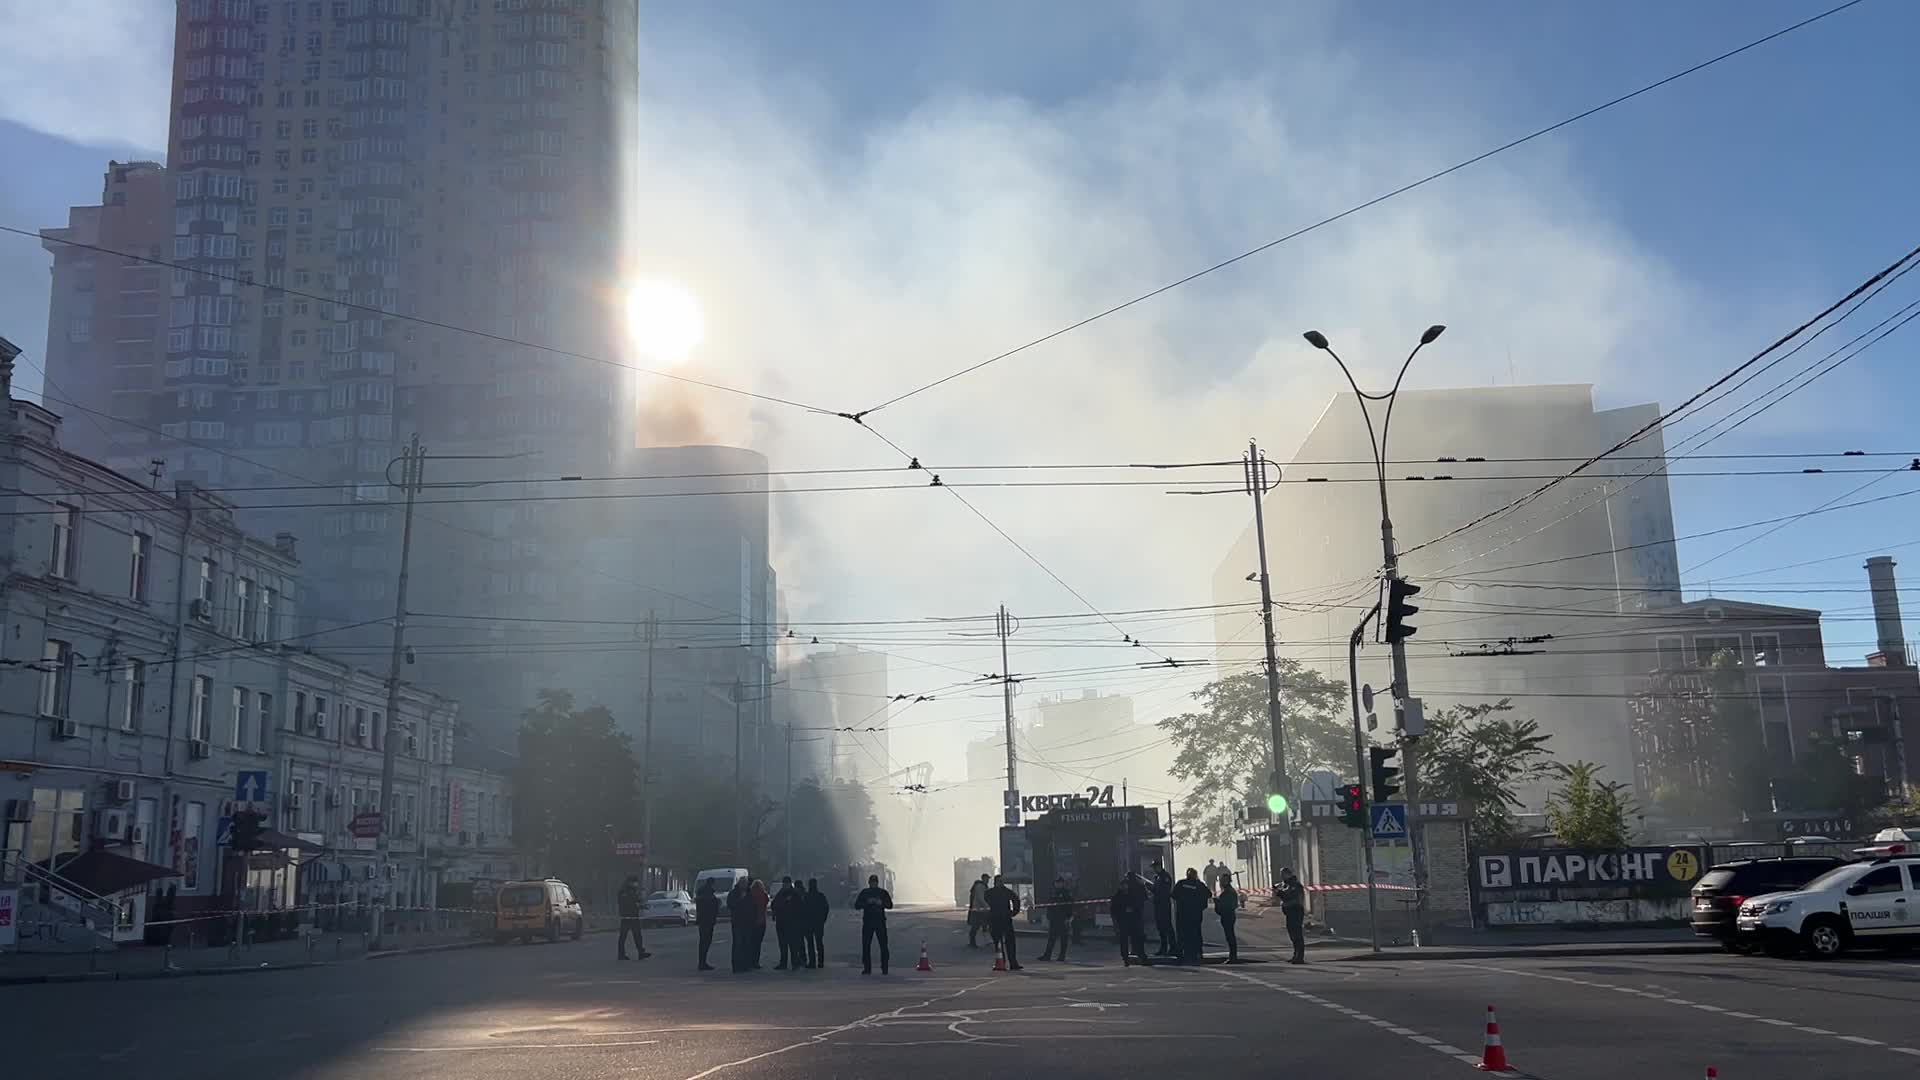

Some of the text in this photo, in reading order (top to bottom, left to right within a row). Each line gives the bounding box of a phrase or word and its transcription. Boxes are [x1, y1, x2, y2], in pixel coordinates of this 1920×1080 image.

[1086, 785, 1115, 806] 24
[1675, 853, 1689, 865] 24
[1680, 867, 1687, 879] 7
[1850, 910, 1891, 921] ПОЛІЦІЯ
